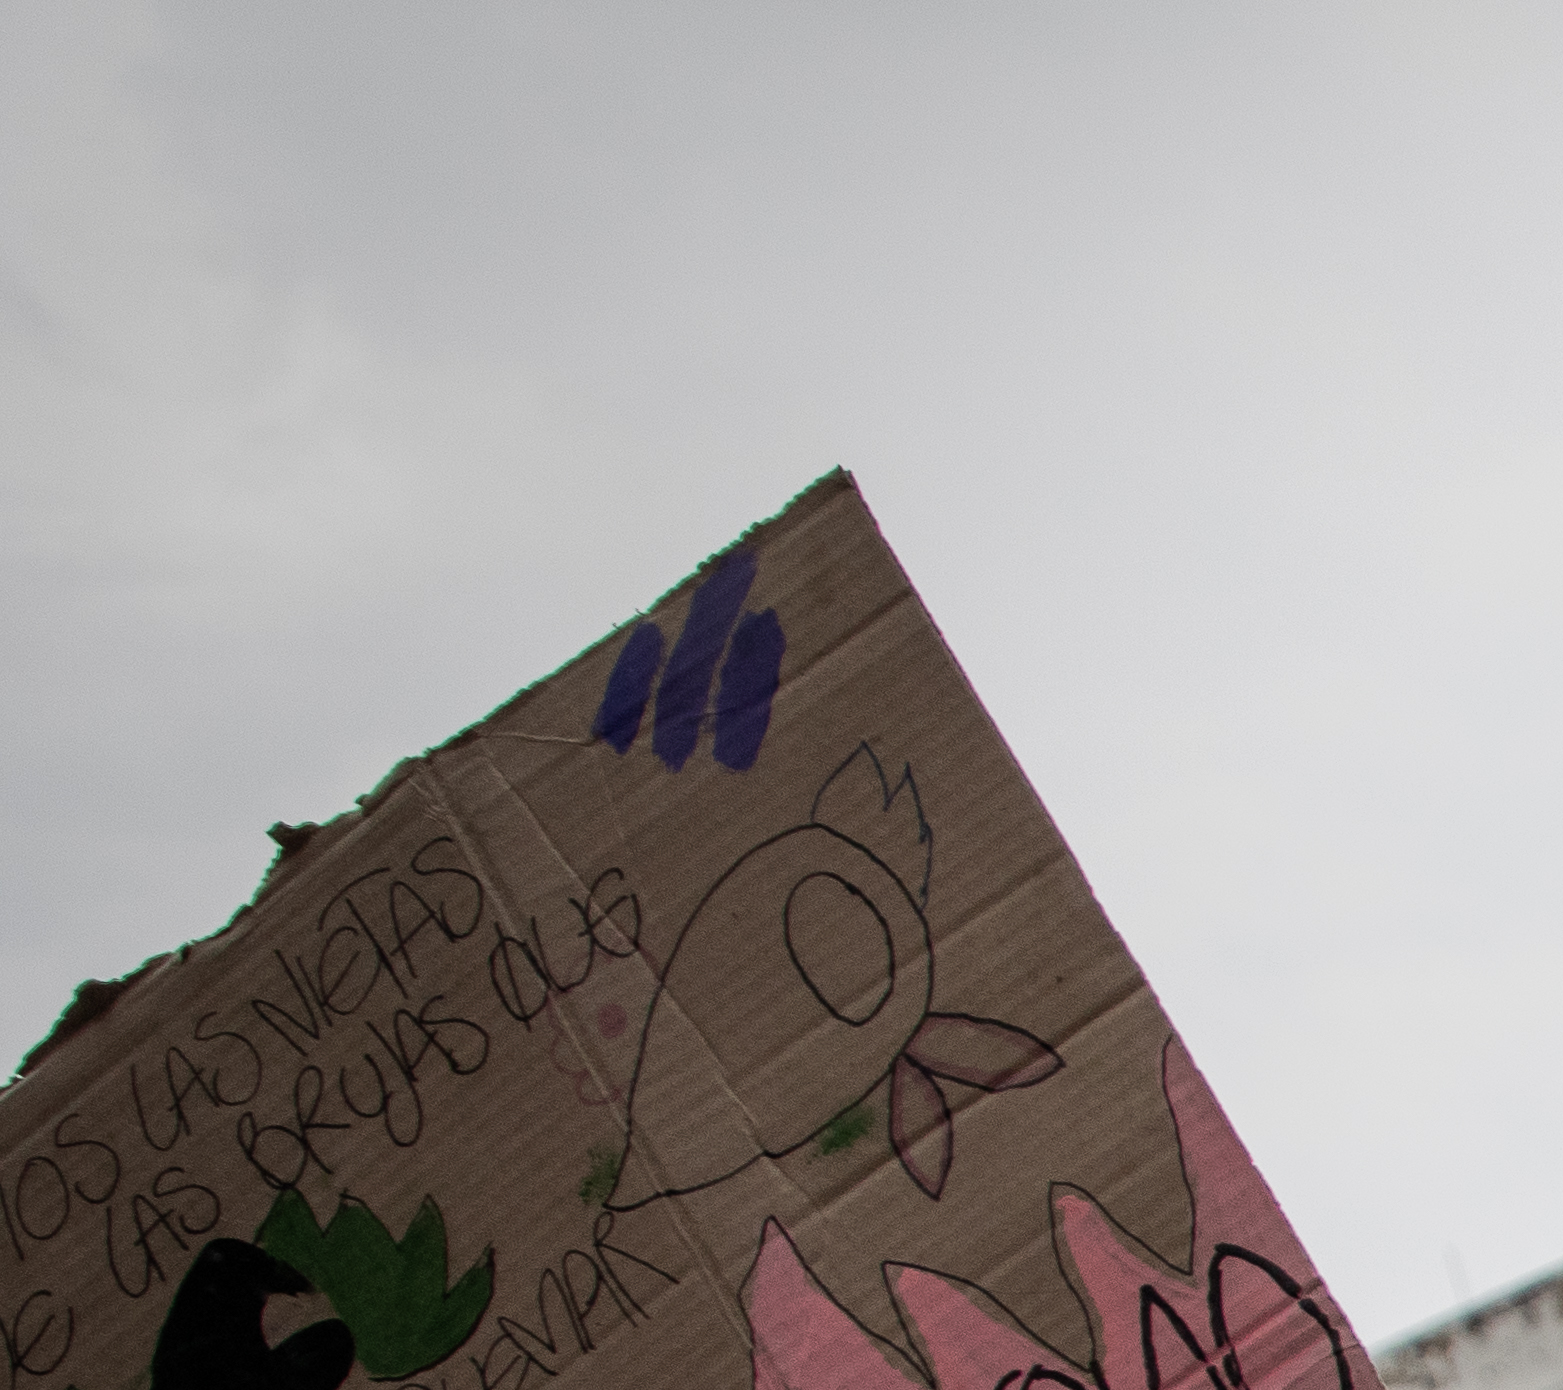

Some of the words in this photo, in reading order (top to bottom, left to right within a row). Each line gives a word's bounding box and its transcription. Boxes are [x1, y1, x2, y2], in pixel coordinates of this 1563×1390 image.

[107, 1167, 221, 1299] LAS
[237, 994, 490, 1190] BRUJAS
[130, 1011, 263, 1151] LAS
[253, 836, 485, 1057] NIETAS
